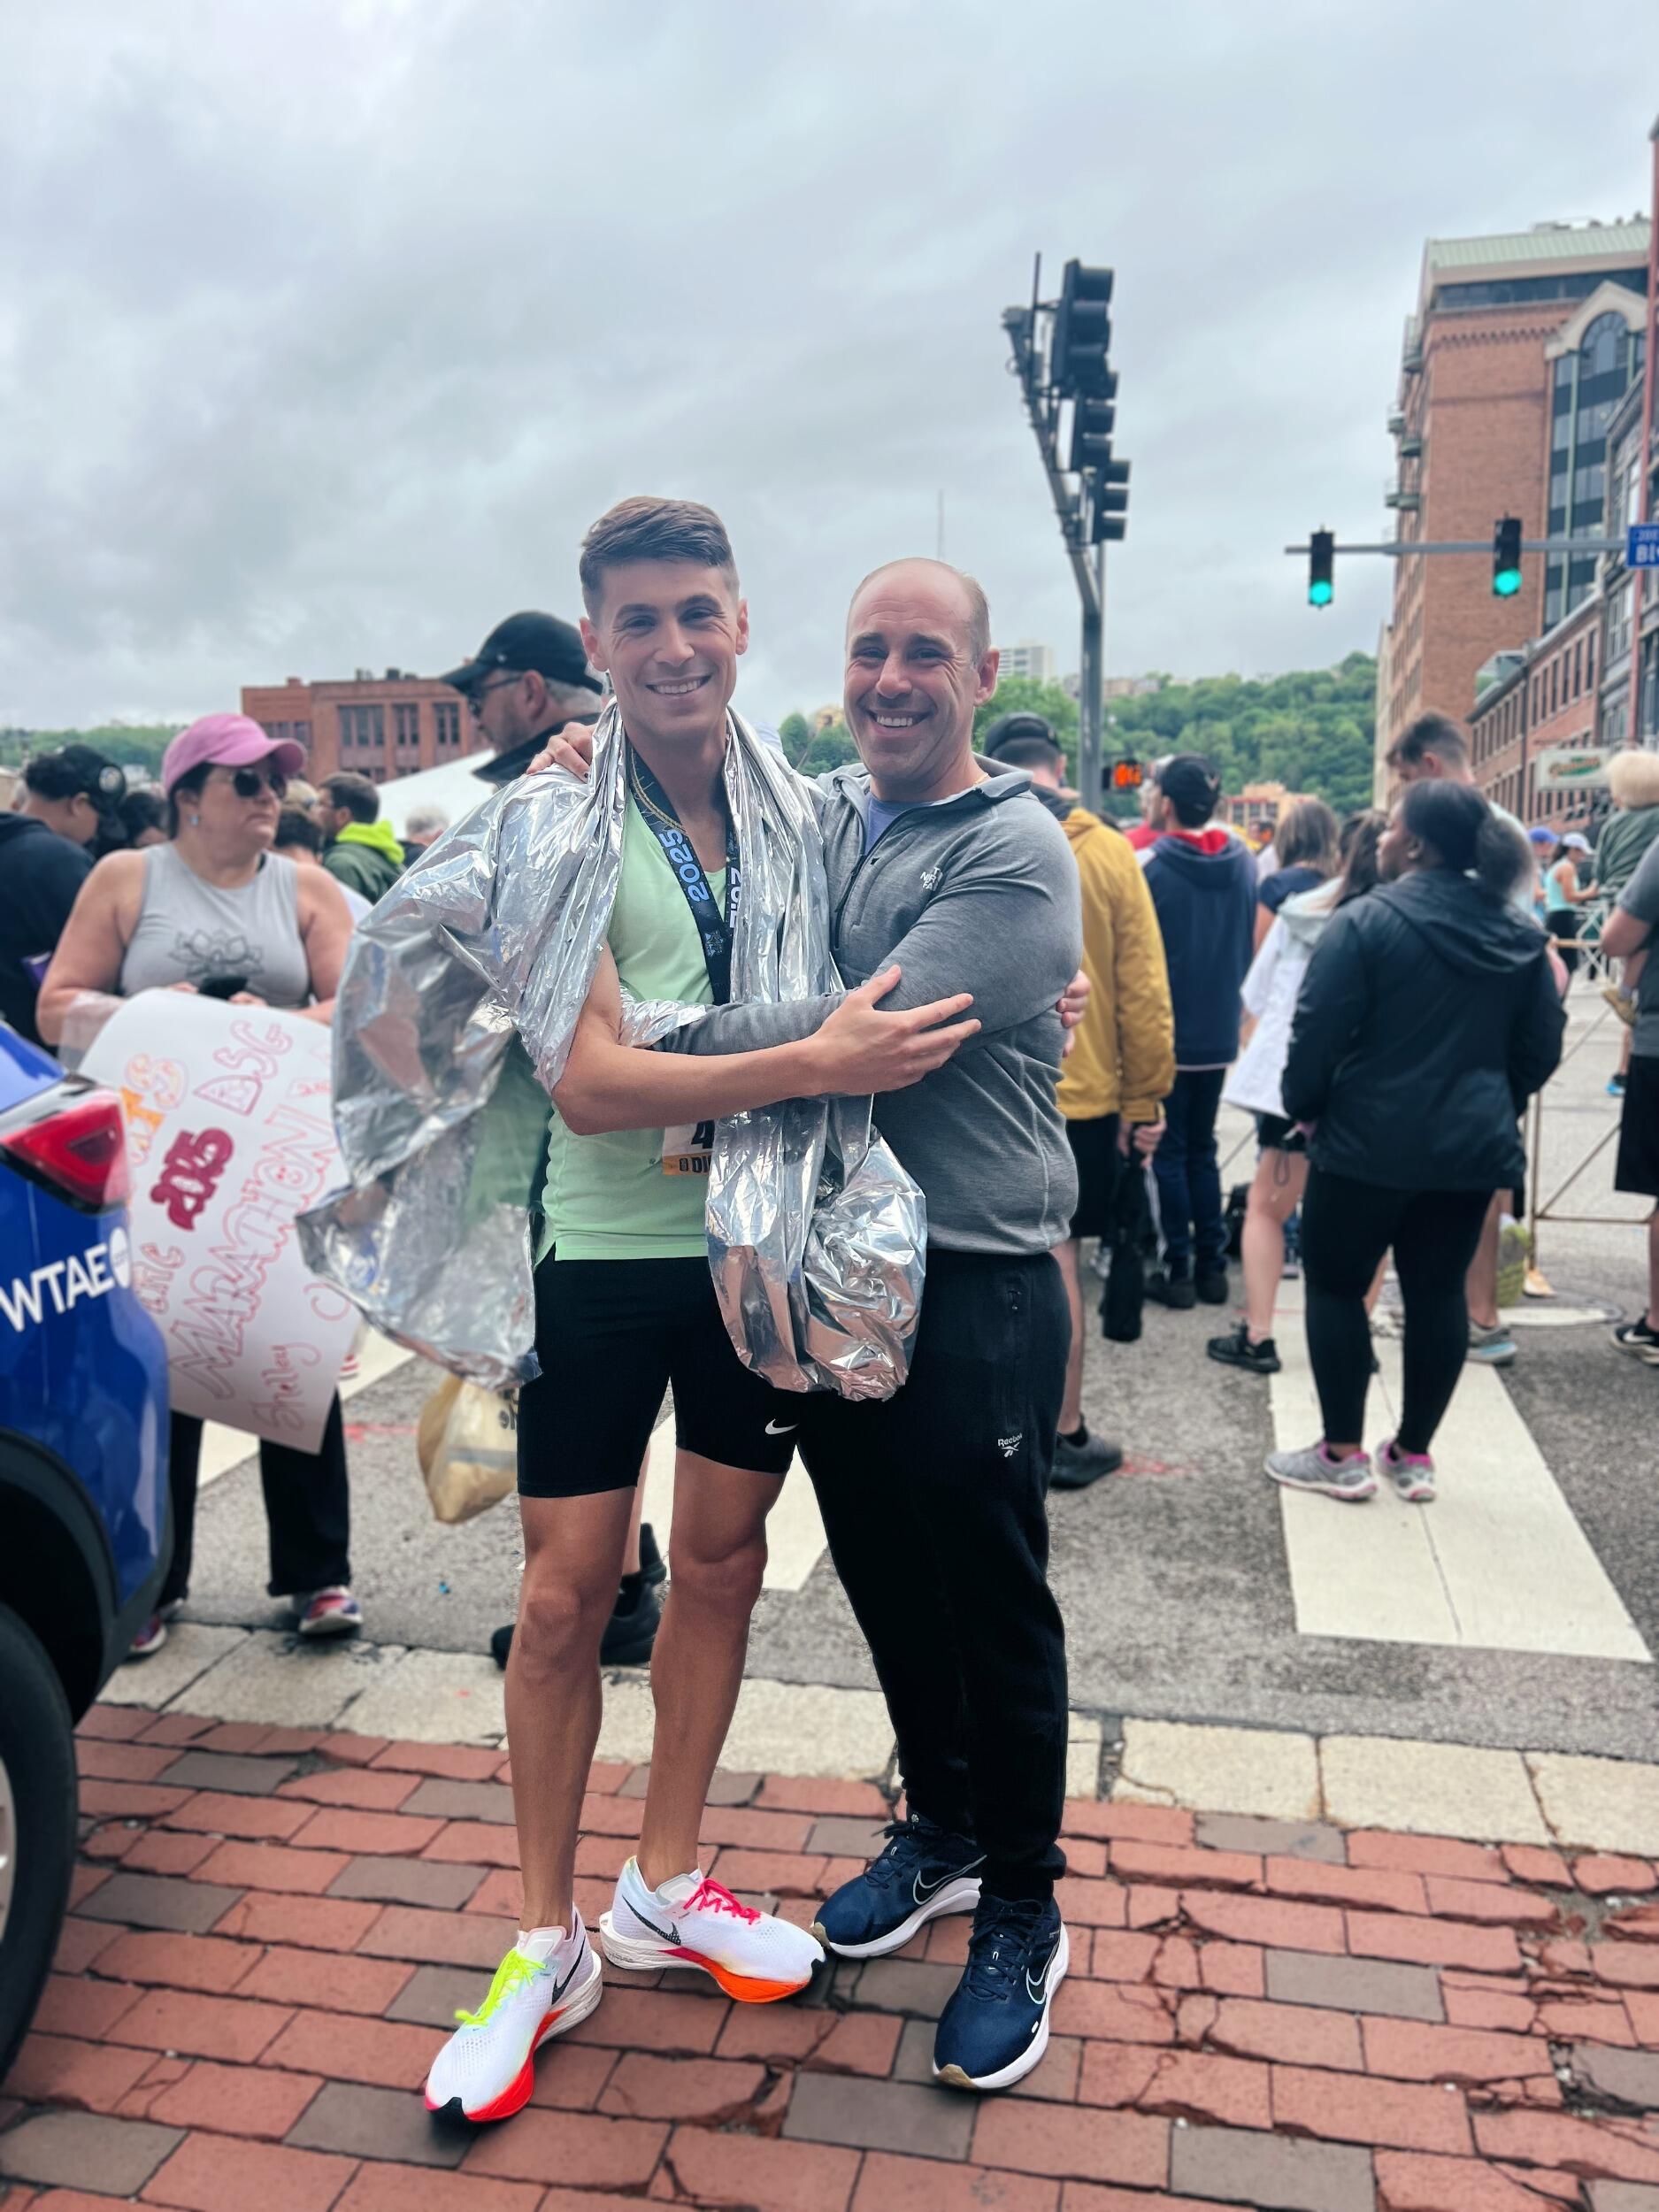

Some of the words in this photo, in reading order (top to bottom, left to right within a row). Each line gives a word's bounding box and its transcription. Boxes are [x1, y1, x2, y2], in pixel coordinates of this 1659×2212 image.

[658, 829, 710, 902] 2025
[149, 1126, 234, 1232] 2025
[192, 1019, 294, 1117] DSG
[0, 1241, 117, 1333] WTAE
[997, 1432, 1023, 1448] Reebok
